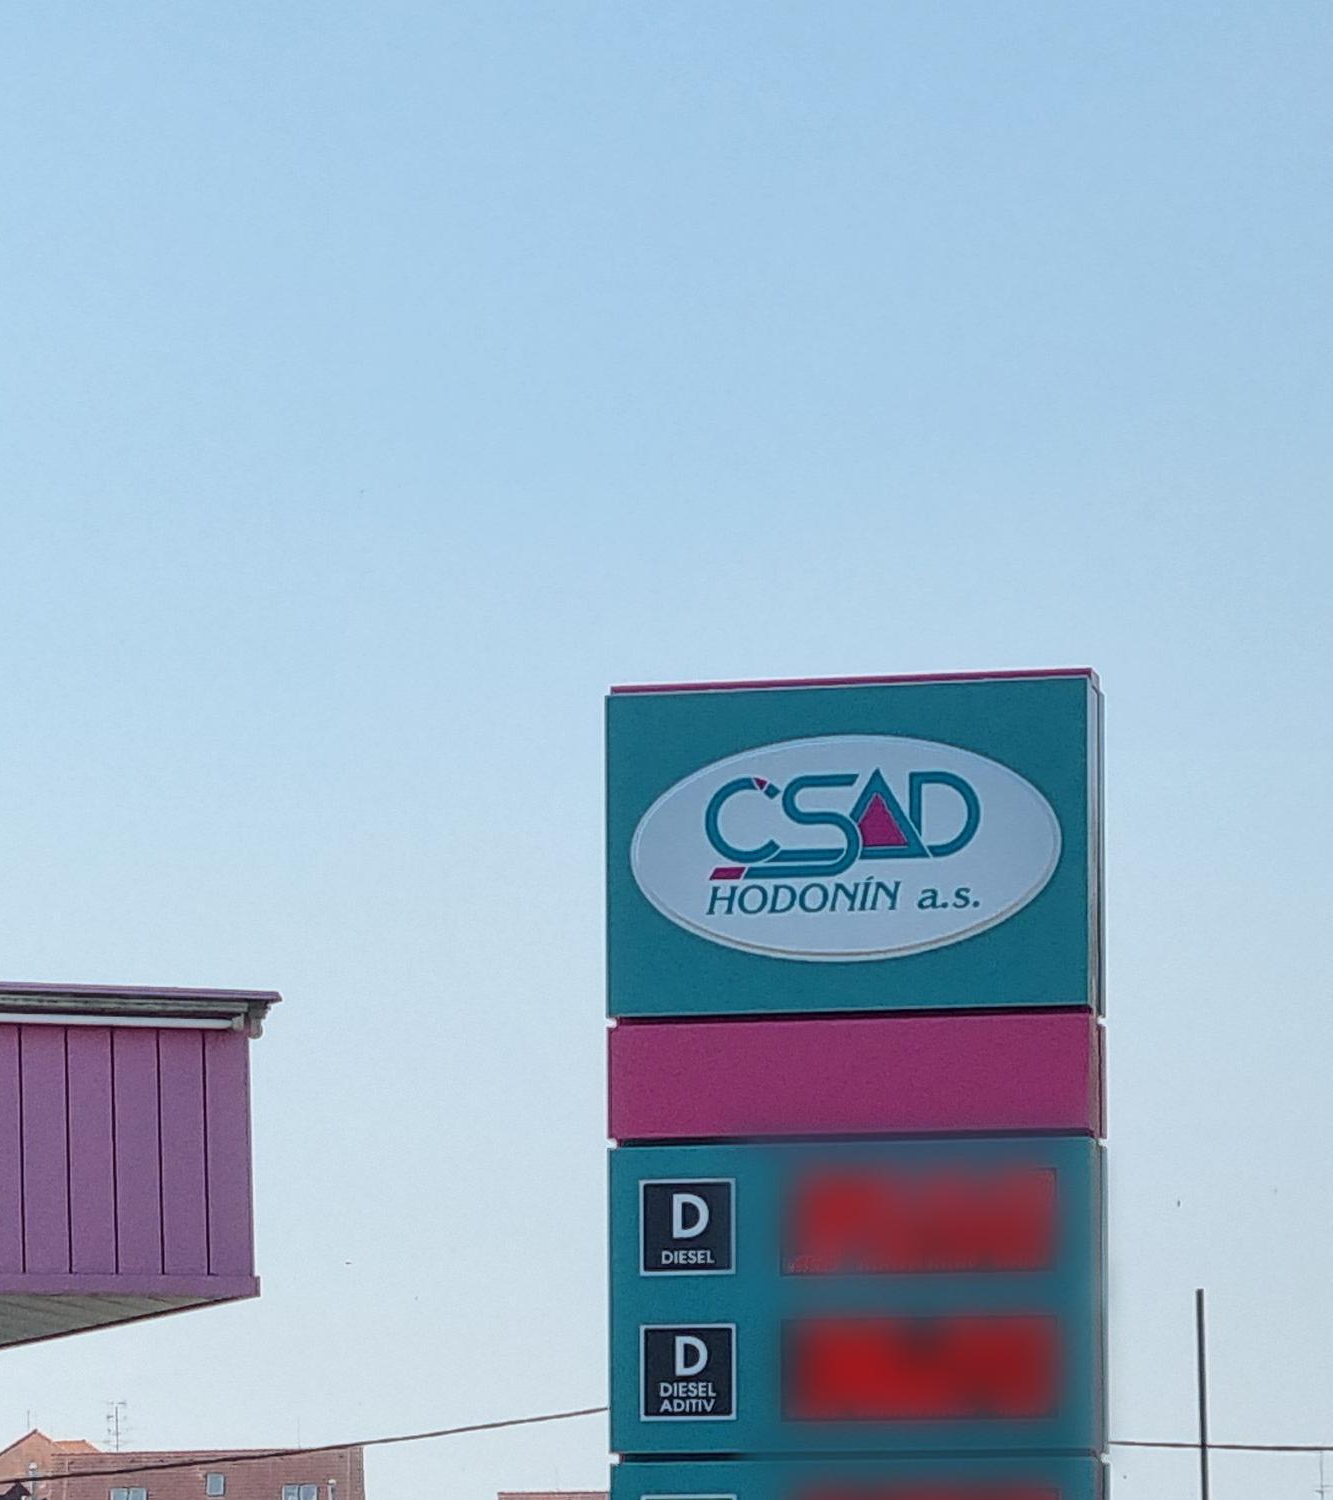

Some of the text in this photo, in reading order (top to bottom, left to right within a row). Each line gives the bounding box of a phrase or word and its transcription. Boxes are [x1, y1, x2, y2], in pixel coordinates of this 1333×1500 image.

[706, 876, 981, 916] HODONÍN a.s.
[672, 1193, 709, 1240] D
[660, 1250, 715, 1265] DIESEL
[674, 1336, 708, 1377] D
[659, 1382, 717, 1398] DIESEL
[659, 1399, 716, 1413] ADITIV
